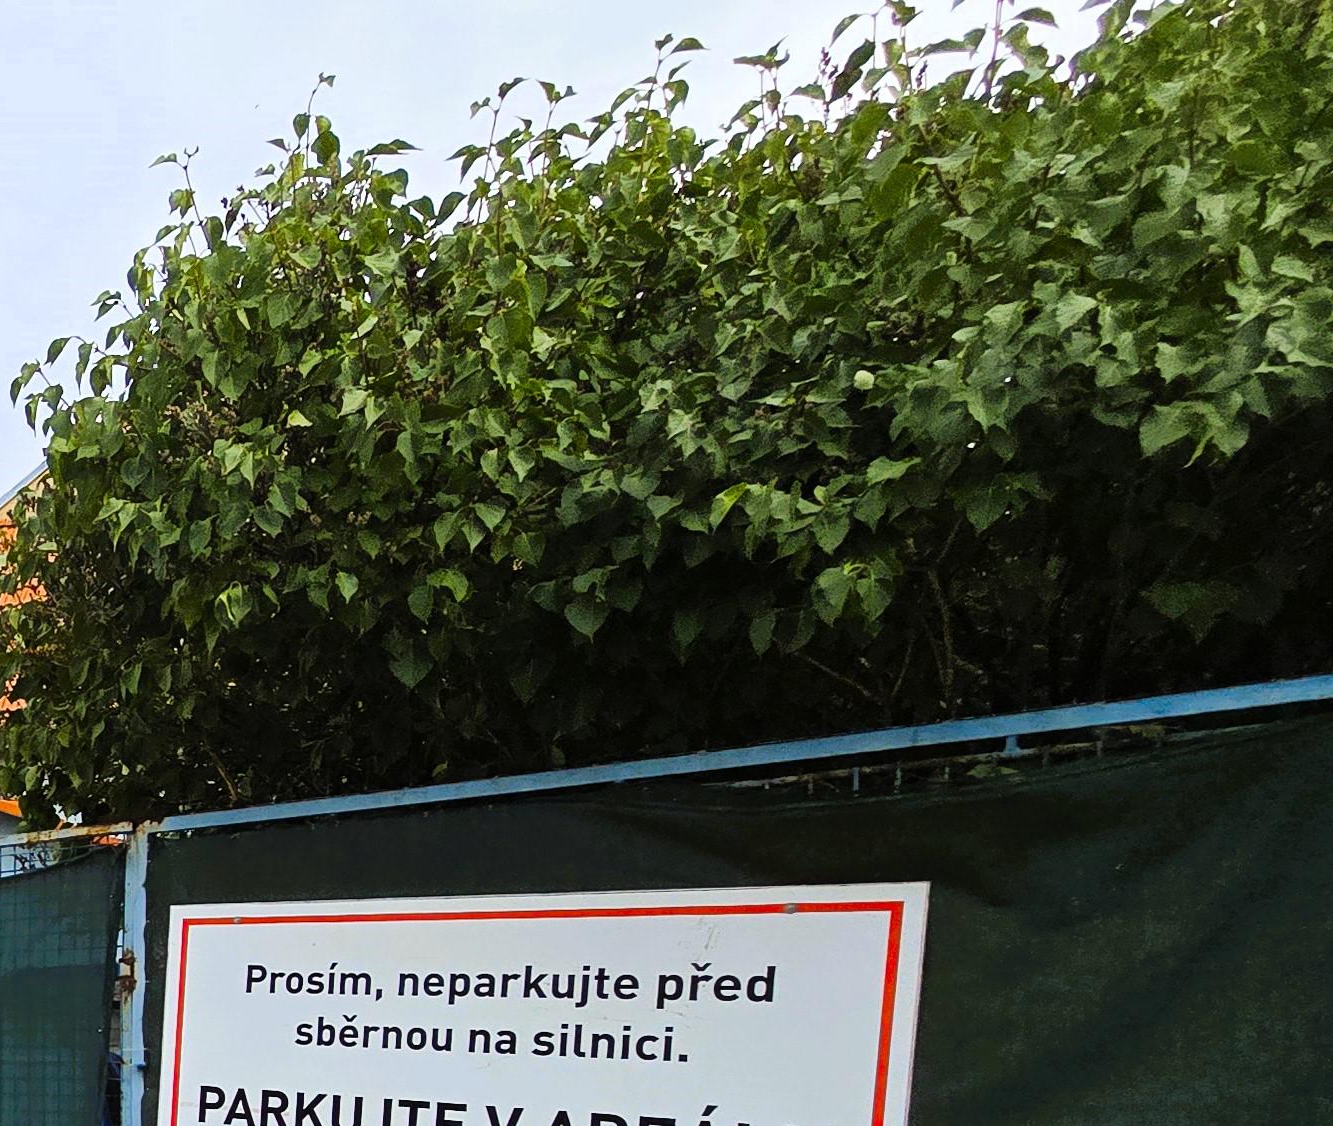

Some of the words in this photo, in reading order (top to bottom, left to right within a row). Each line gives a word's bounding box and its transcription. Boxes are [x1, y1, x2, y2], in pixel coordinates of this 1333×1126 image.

[244, 962, 384, 1003] Prosím,
[396, 964, 641, 1009] neparkujte
[655, 962, 778, 1011] před
[294, 1013, 454, 1053] sběrnou
[467, 1028, 518, 1056] na
[531, 1022, 690, 1064] silnici.
